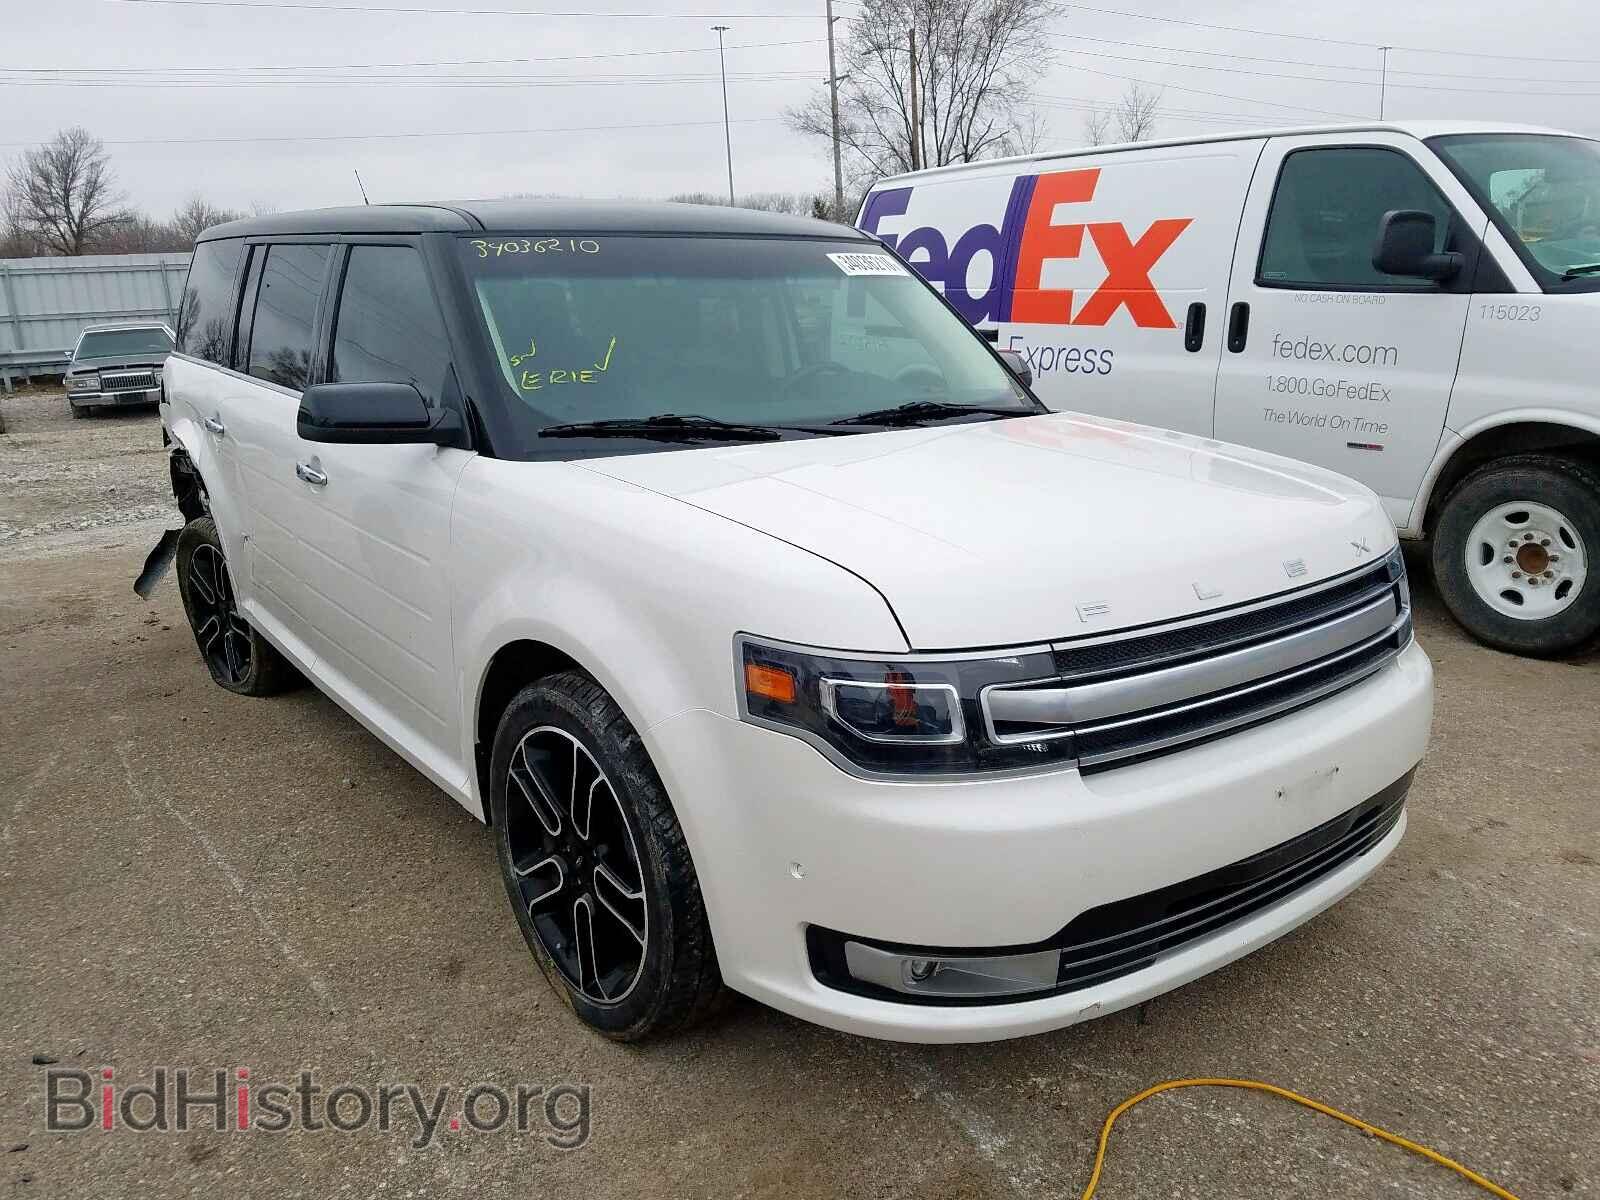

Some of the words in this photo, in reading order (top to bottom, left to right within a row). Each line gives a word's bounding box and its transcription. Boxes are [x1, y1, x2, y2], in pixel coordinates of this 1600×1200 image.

[471, 238, 600, 257] 34036210
[858, 168, 1194, 328] FedEx
[1294, 293, 1308, 303] NO
[1311, 293, 1334, 304] CASH
[1336, 294, 1351, 304] ON
[1352, 295, 1386, 305] BOARD
[1480, 304, 1542, 322] 115023
[1009, 336, 1114, 378] Express
[1272, 334, 1398, 366] fedex.com
[521, 370, 600, 390] ERIE
[1266, 376, 1392, 402] 1.800.GoFedEx
[1264, 408, 1286, 424] The
[1288, 411, 1327, 428] World
[1330, 415, 1351, 431] On
[1352, 417, 1389, 434] Time
